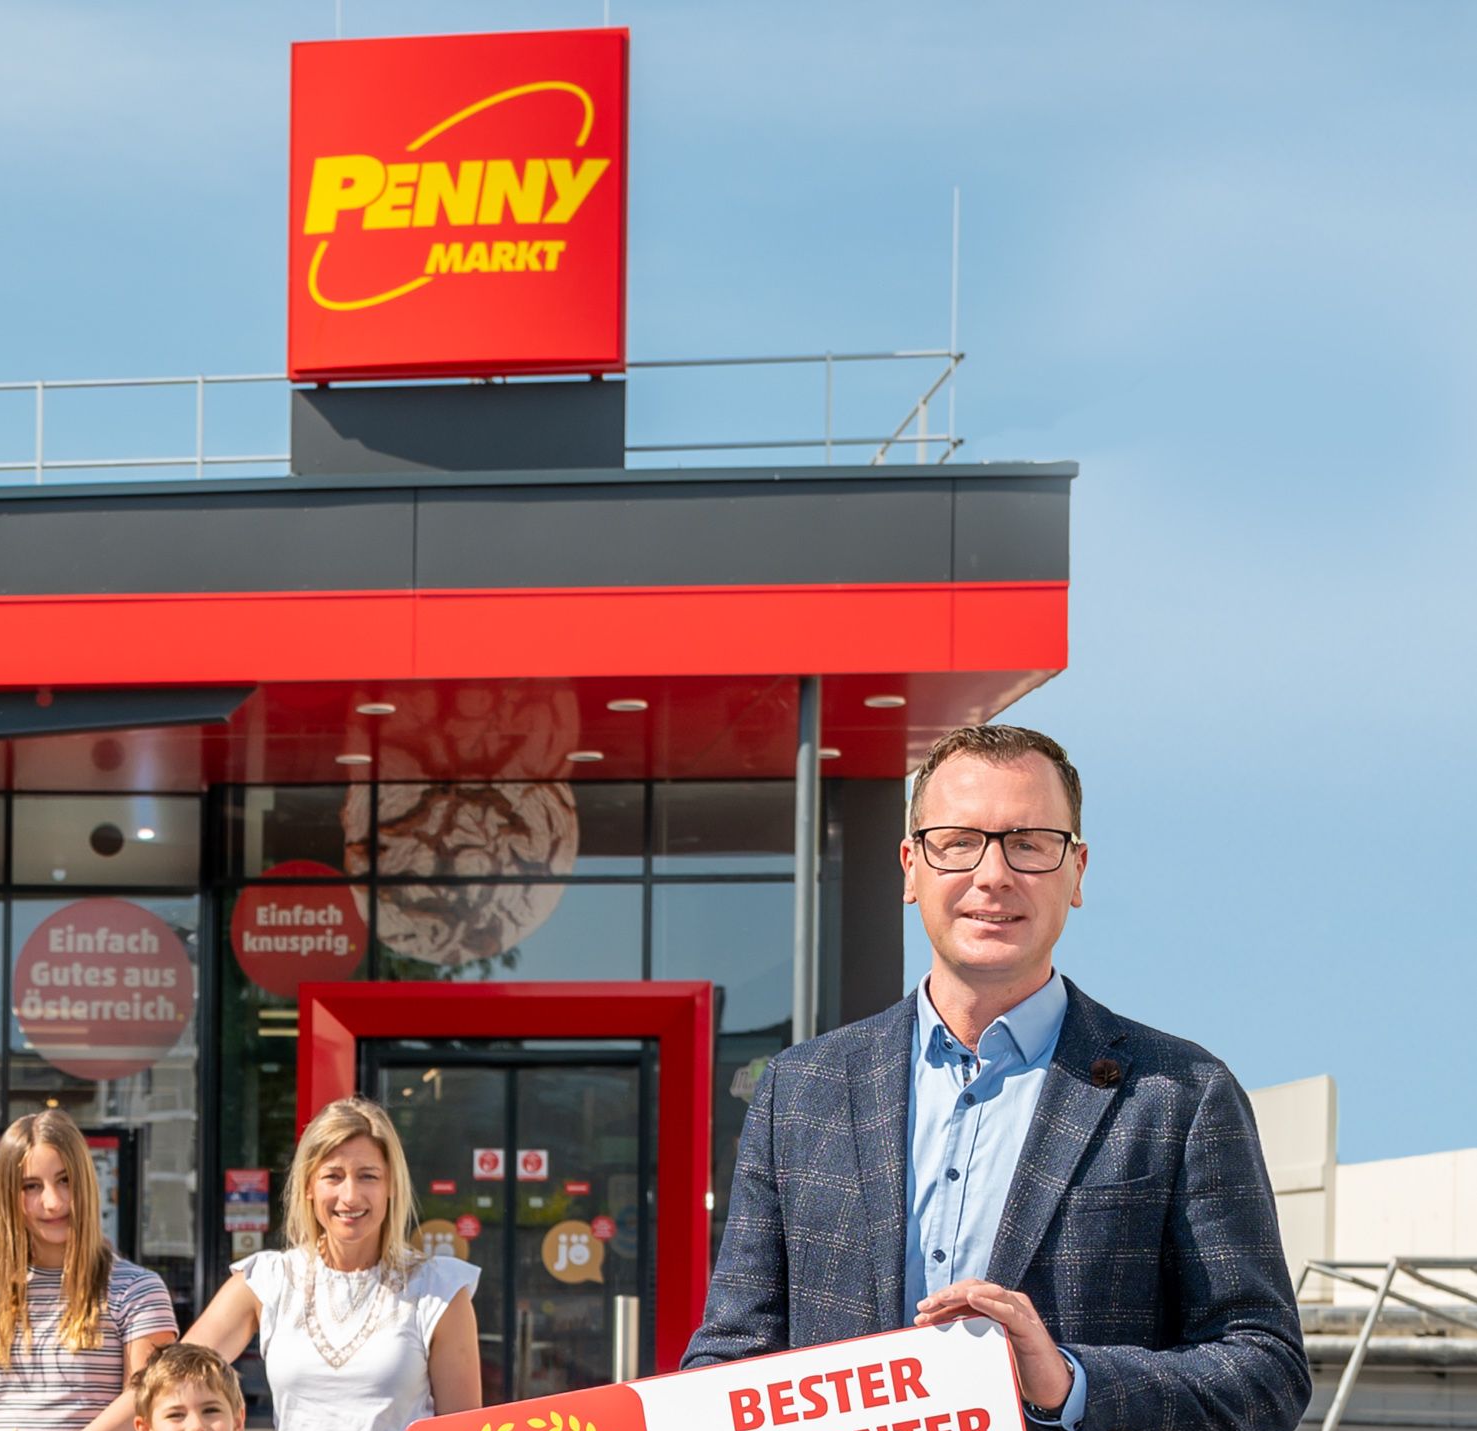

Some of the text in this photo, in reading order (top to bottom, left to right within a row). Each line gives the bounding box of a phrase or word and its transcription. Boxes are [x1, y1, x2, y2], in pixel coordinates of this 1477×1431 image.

[303, 153, 612, 236] PENNY
[424, 240, 567, 275] MARKT
[255, 903, 344, 926] Einfach
[48, 924, 160, 954] Einfach
[242, 928, 356, 957] knusprig.
[30, 961, 177, 987] Gutes aus
[21, 988, 185, 1021] Österreich.
[553, 1233, 591, 1271] jö
